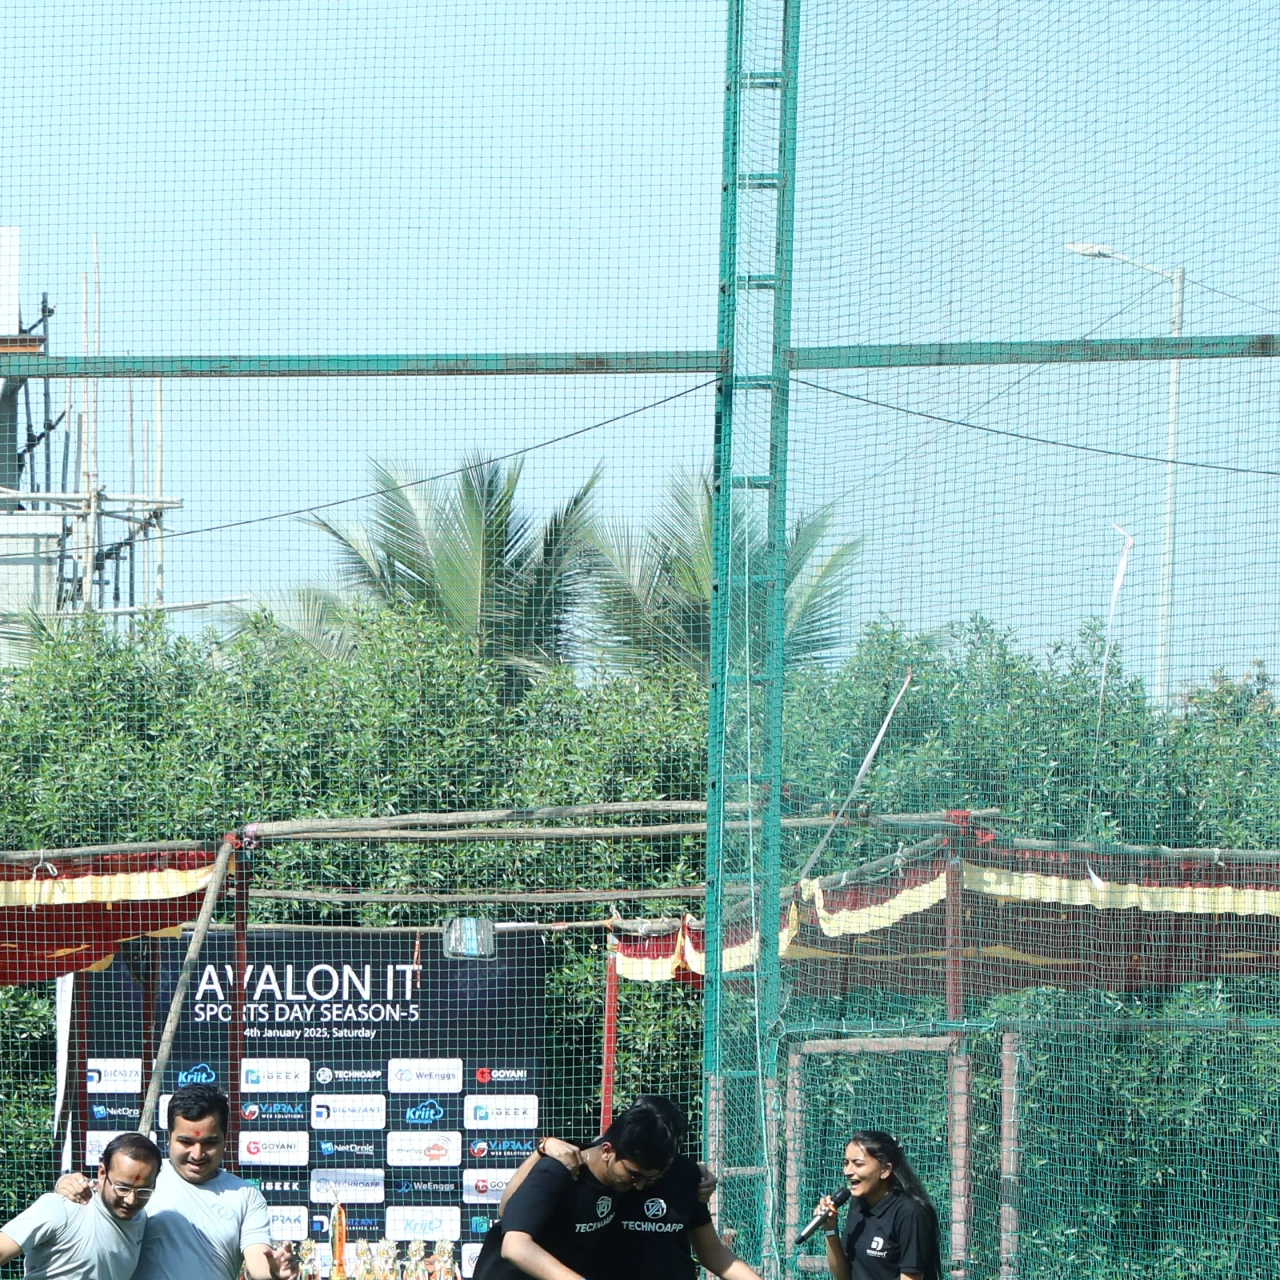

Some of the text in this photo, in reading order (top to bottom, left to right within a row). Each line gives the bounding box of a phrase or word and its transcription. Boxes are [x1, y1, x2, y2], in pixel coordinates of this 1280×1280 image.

[195, 964, 423, 1001] AVALON IT
[194, 1003, 420, 1022] SPOTS DAY SEASON-5
[262, 1029, 302, 1039] January
[303, 1029, 330, 1039] 2025,
[332, 1029, 377, 1039] Saturday
[103, 1070, 140, 1078] DIGNIZA
[334, 1070, 382, 1079] TECHNOAPP
[415, 1070, 456, 1081] WeEnggs
[491, 1069, 527, 1078] GOYANI
[106, 1107, 140, 1115] NetDro
[406, 1107, 436, 1119] Kriit
[413, 1182, 455, 1191] WeEnggs
[621, 1221, 684, 1232] TECHNOAPP
